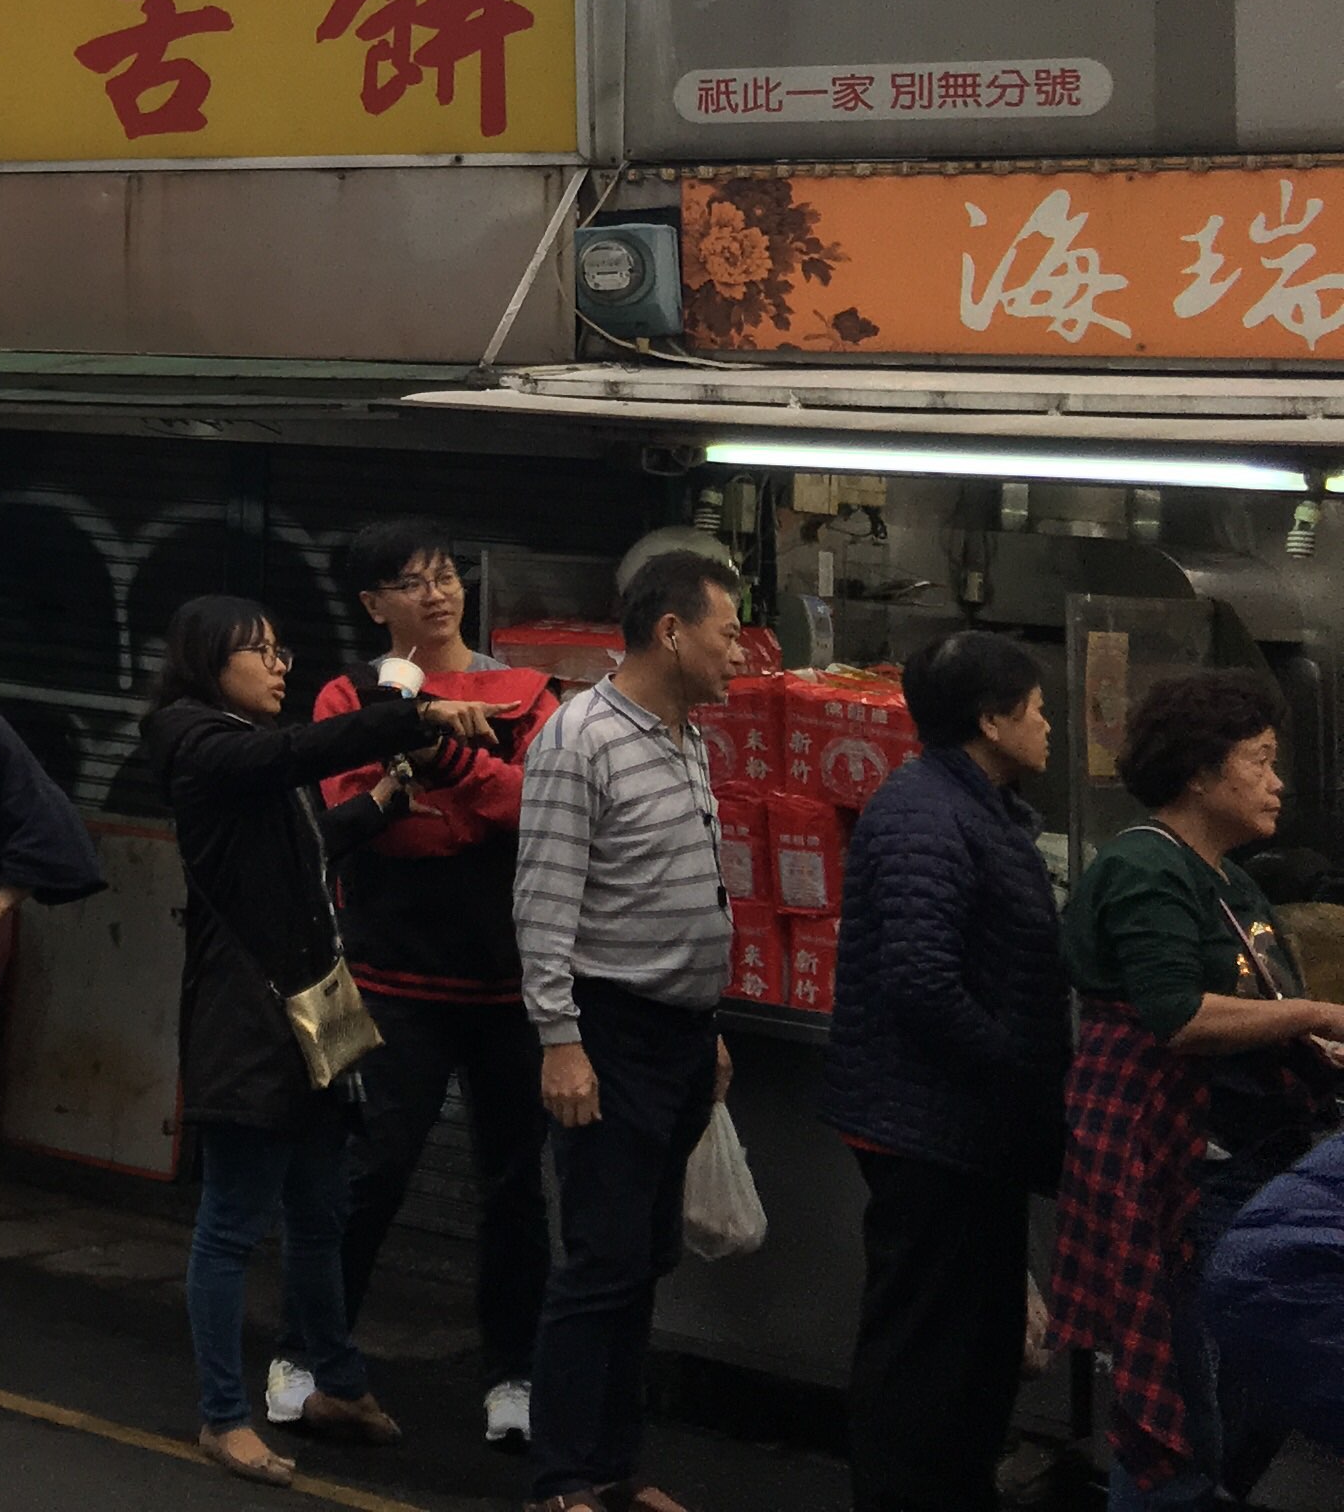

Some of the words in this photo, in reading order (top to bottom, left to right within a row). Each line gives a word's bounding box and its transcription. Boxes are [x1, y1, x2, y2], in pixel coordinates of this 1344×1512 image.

[890, 67, 1082, 111] 別無分號
[789, 730, 811, 784] 新竹
